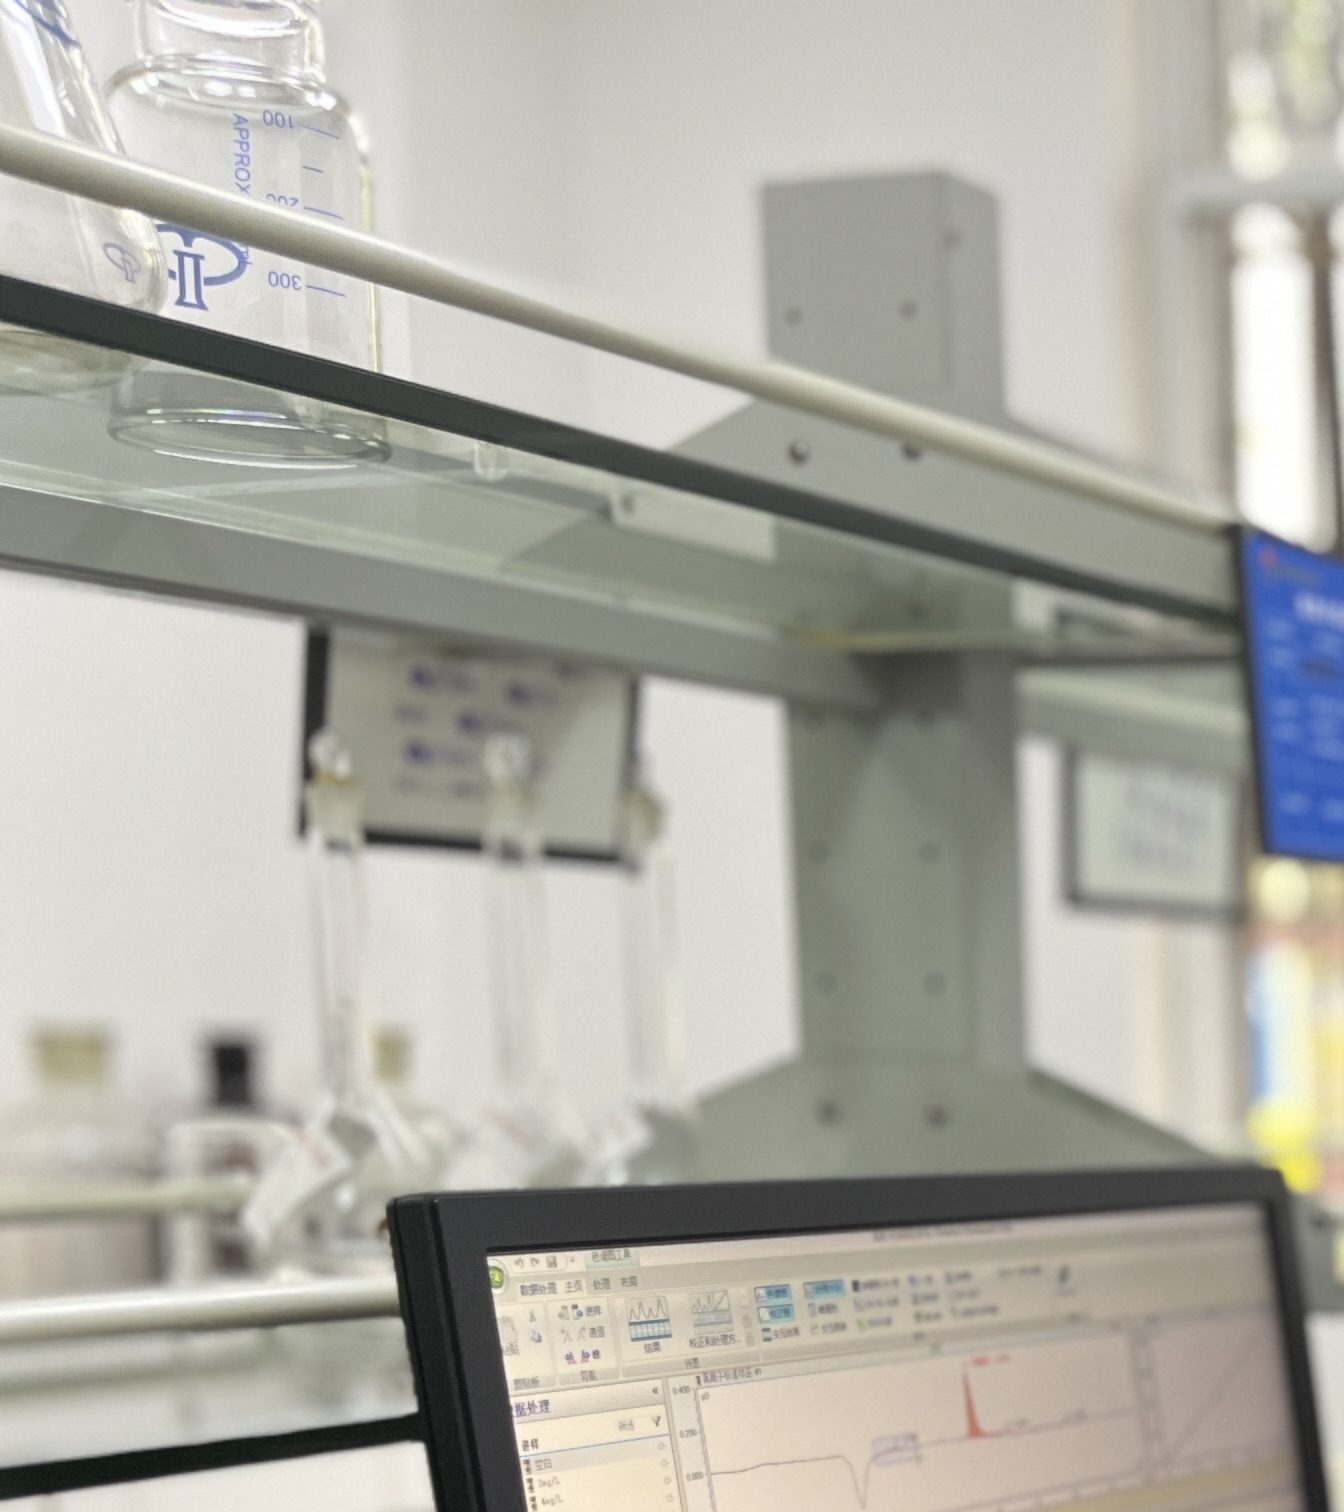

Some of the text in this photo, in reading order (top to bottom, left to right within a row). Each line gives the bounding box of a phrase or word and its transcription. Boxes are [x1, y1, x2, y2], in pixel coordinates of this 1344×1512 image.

[263, 110, 294, 129] 100
[232, 113, 251, 195] APPROX
[268, 271, 302, 291] 300
[565, 1281, 582, 1292] 主页
[593, 1278, 610, 1290] 处理
[620, 1276, 637, 1287] 布局
[644, 1342, 660, 1353] 结果
[513, 1399, 550, 1417] 据处理
[534, 1458, 552, 1470] 空白
